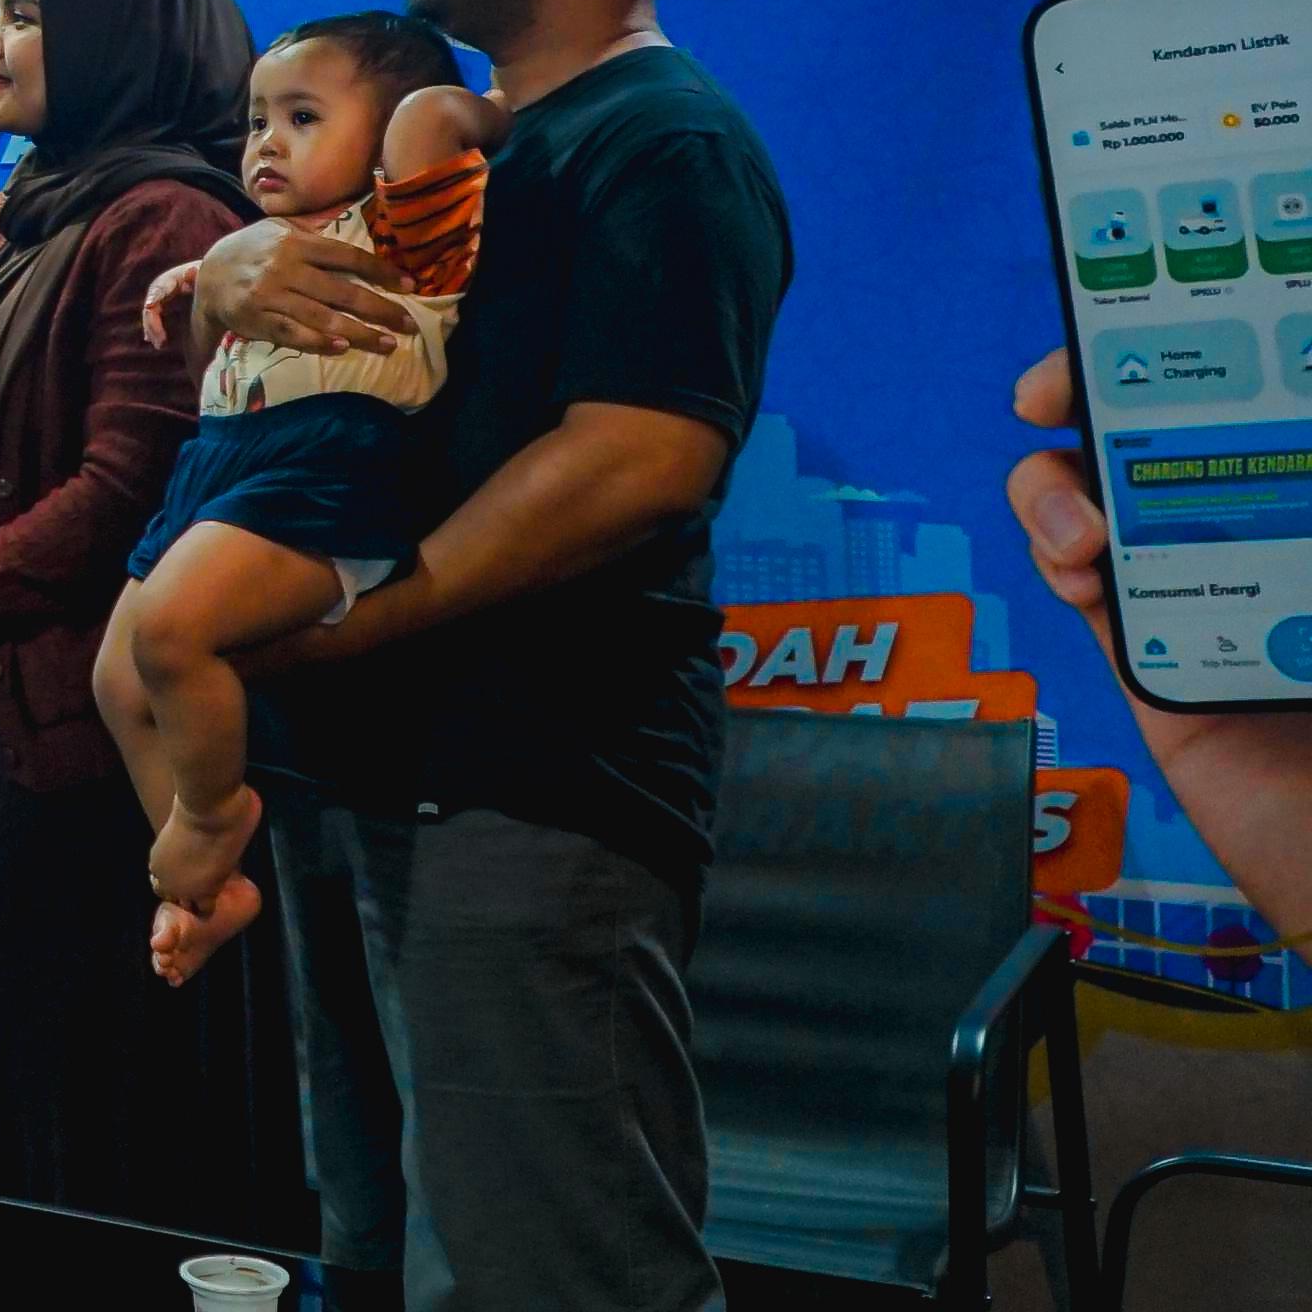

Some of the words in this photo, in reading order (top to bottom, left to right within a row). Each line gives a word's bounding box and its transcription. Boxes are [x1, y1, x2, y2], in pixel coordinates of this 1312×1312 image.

[1153, 41, 1237, 63] Kendaraan
[1241, 34, 1290, 51] Listrik
[1251, 103, 1268, 113] EV
[1102, 139, 1121, 150] Rp
[1124, 132, 1185, 147] 1.000.000
[1160, 349, 1202, 362] Home
[1163, 365, 1227, 381] Charging
[1128, 584, 1205, 599] Konsumsi
[1209, 582, 1261, 598] Energi
